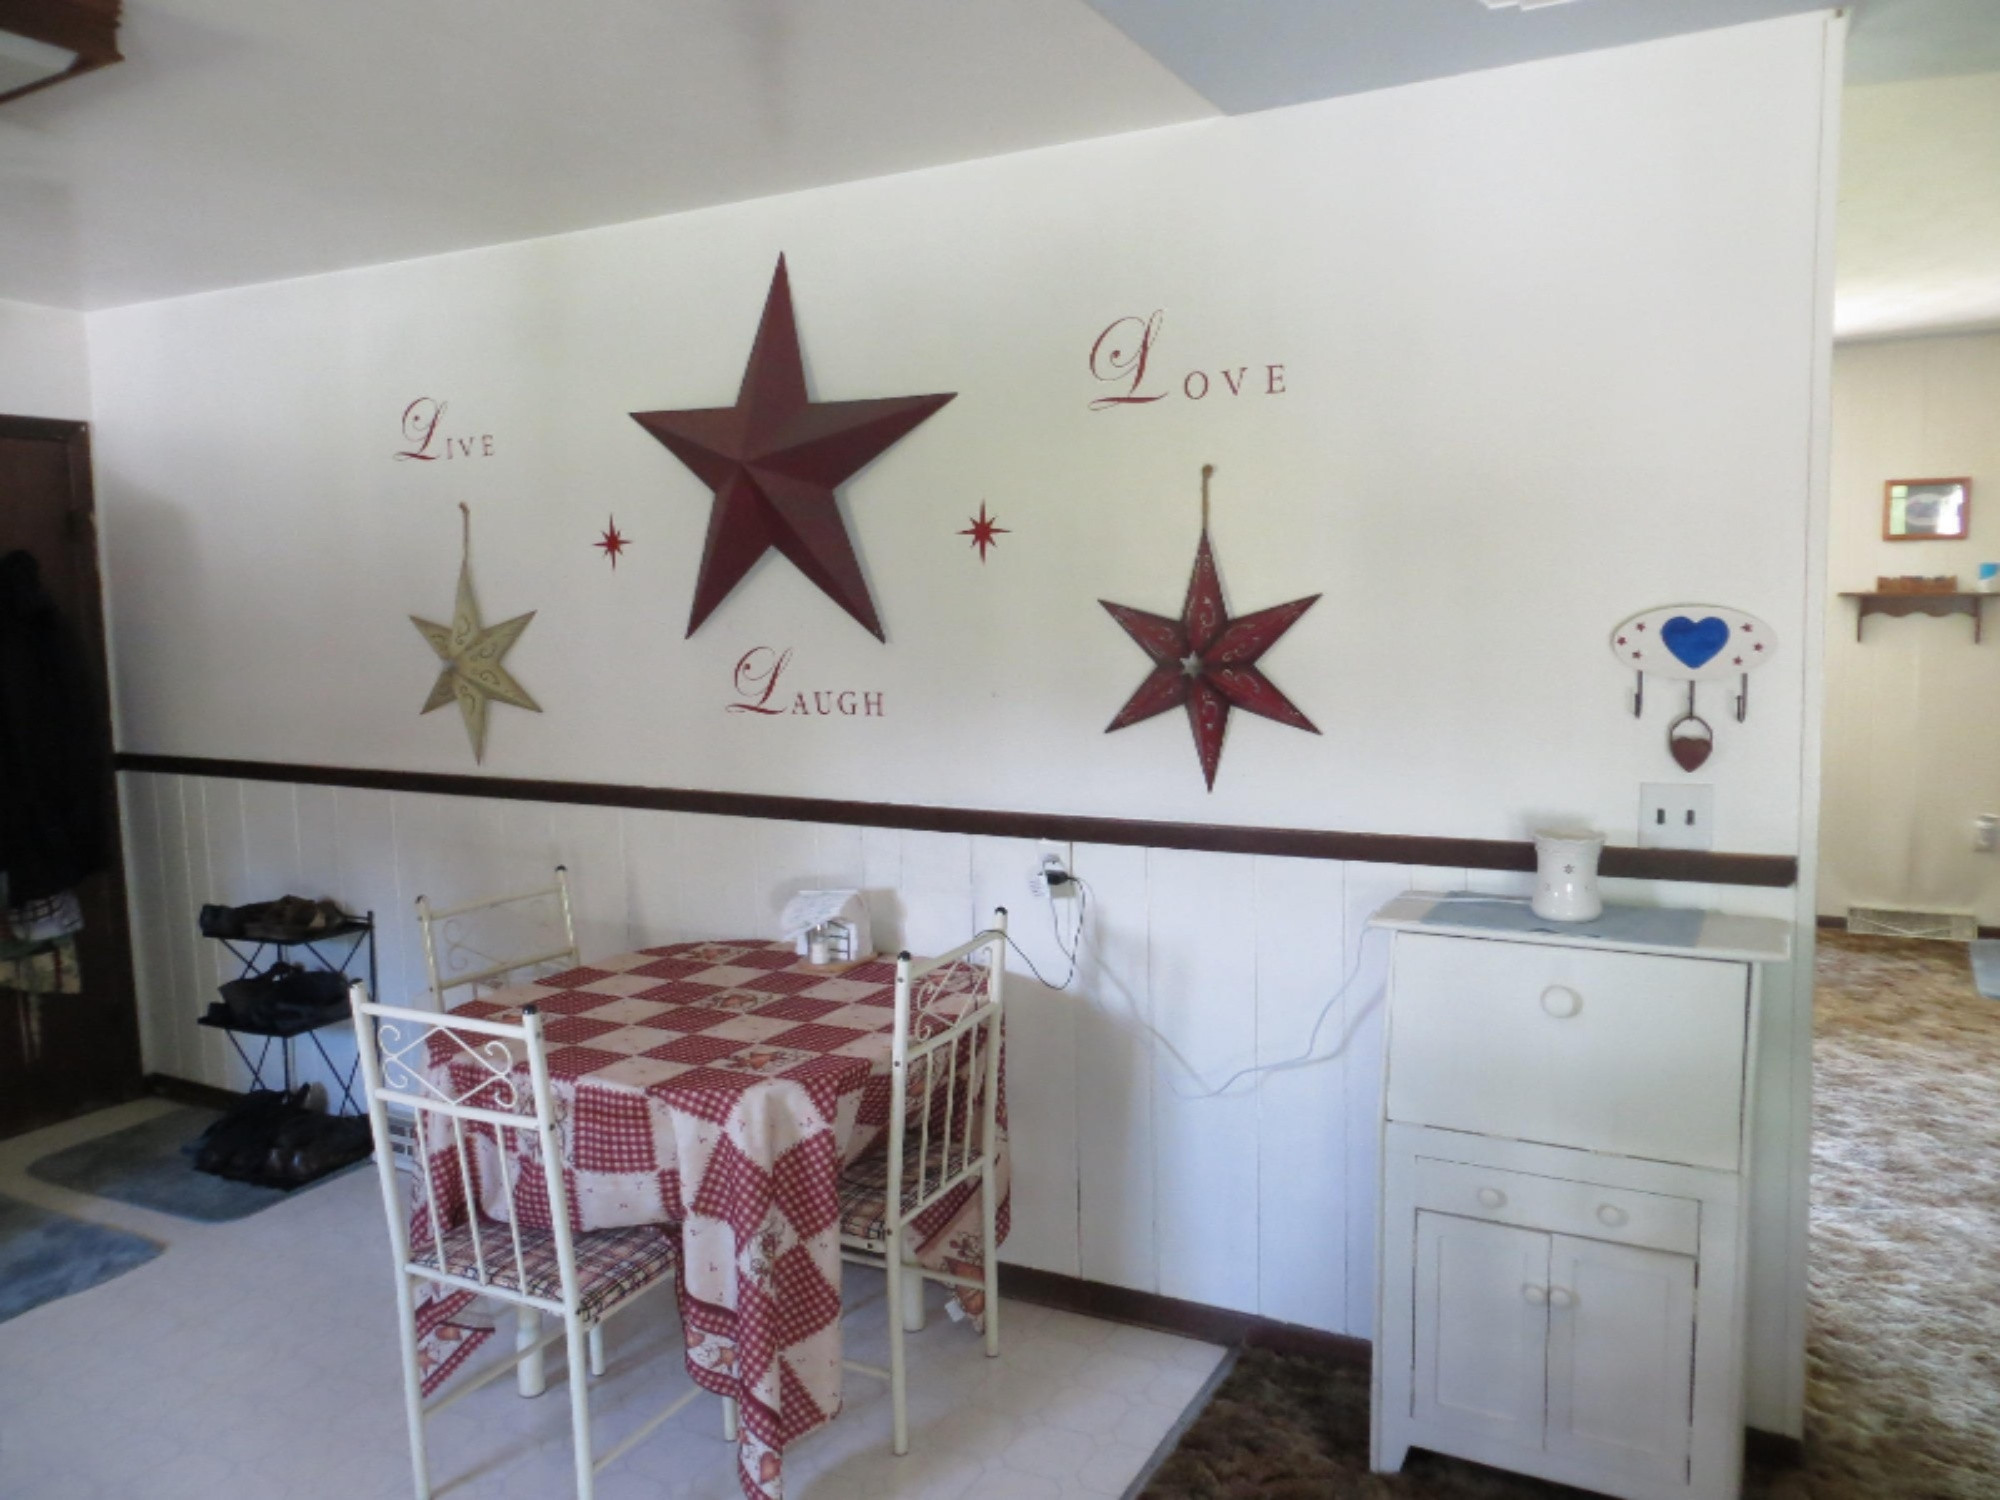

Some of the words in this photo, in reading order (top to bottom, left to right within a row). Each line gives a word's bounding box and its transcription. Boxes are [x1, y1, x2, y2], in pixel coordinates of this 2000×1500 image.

[1088, 309, 1288, 411] LOVE
[393, 396, 495, 461] LIVE
[726, 646, 884, 717] LAUGH
